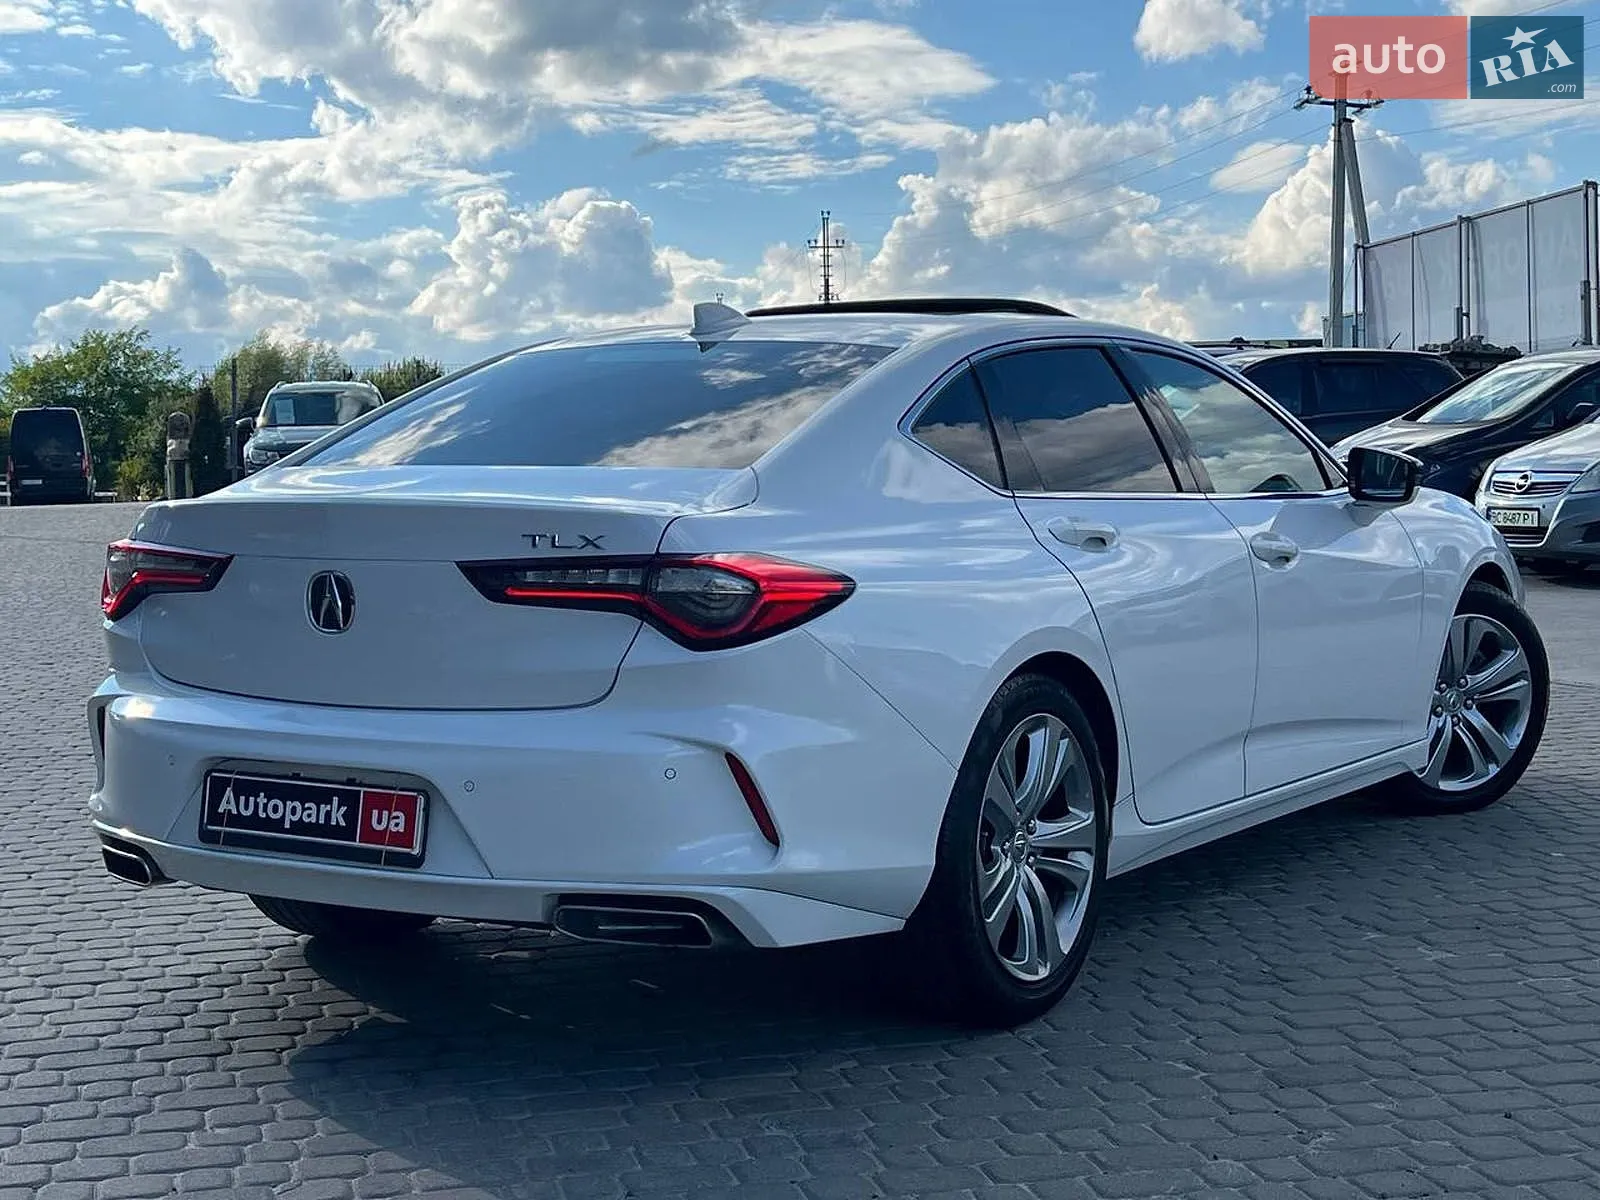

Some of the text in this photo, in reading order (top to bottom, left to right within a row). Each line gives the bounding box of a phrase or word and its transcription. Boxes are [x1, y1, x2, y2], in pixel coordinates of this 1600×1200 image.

[521, 533, 607, 550] TLX
[218, 786, 405, 833] Autopark ua
